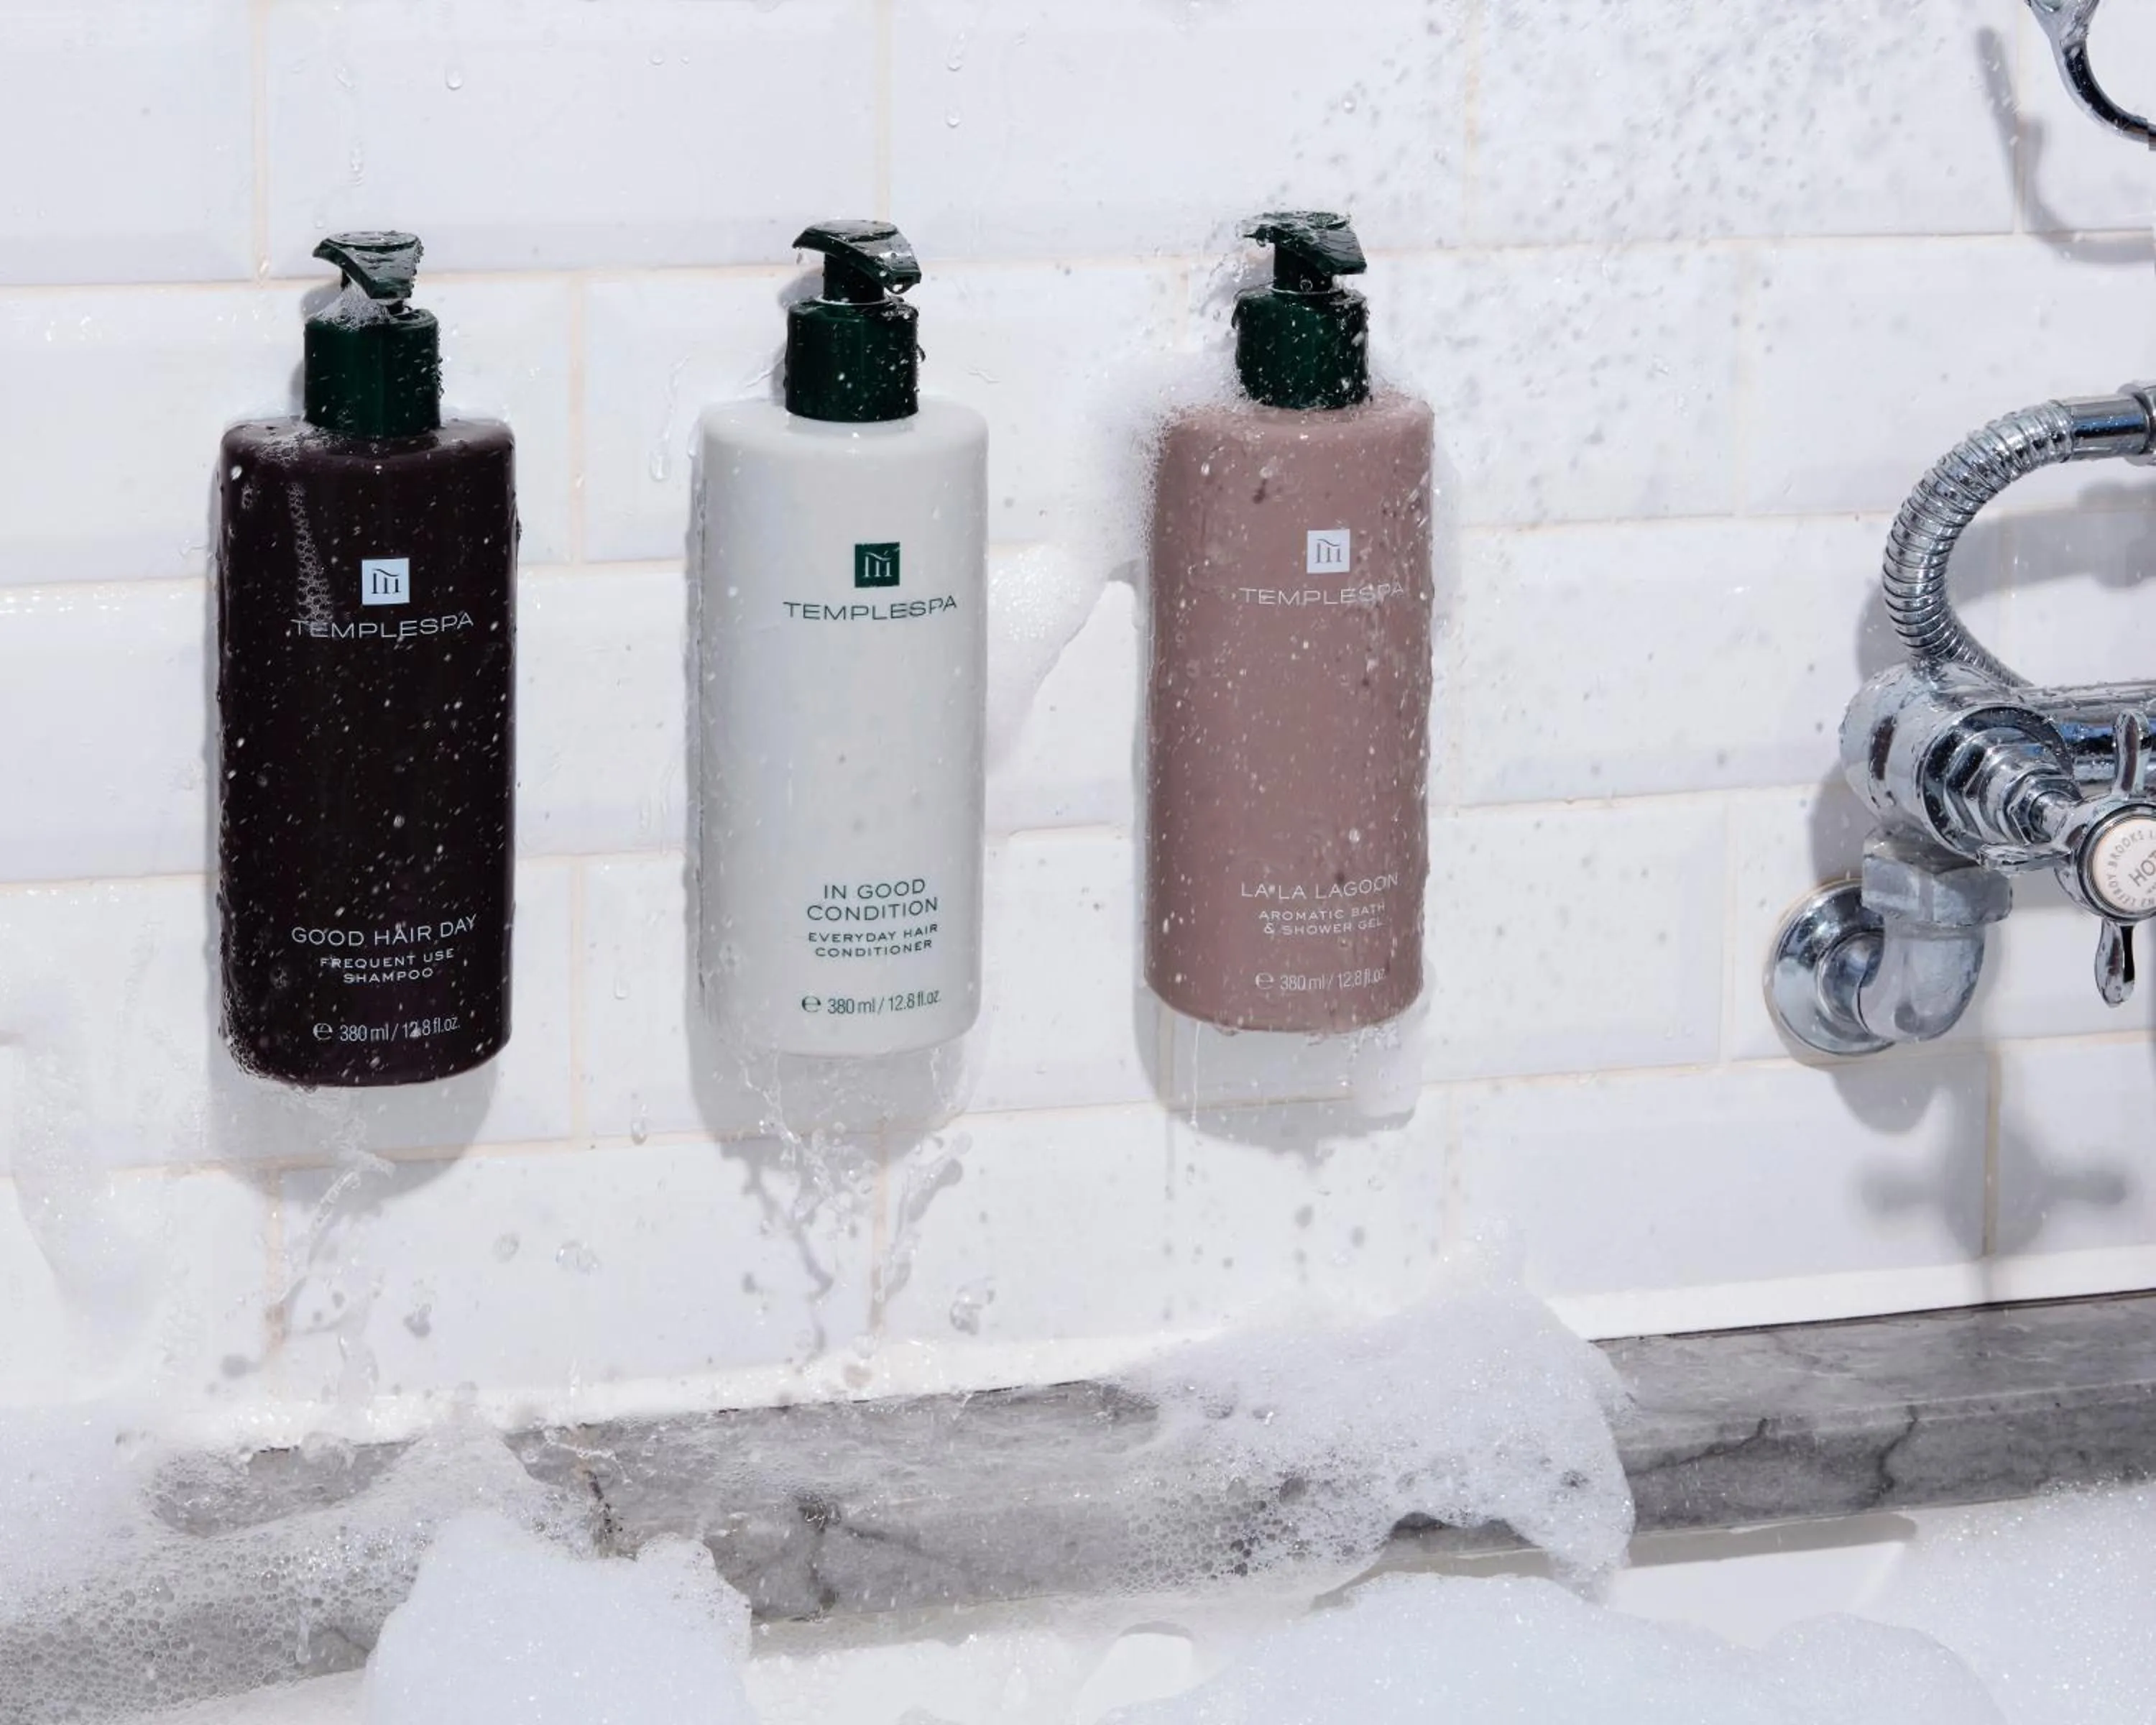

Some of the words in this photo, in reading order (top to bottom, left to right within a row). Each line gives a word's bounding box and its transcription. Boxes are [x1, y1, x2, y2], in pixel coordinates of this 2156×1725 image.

[1239, 576, 1404, 605] TEMPLESPA
[783, 595, 957, 620] TEMPLESPA
[290, 612, 474, 638] TEMPLESPA
[2107, 830, 2145, 868] BROOKS
[824, 885, 847, 899] IN
[857, 878, 926, 899] GOOD
[1241, 883, 1269, 898] LA
[1279, 885, 1307, 901] LA
[1315, 872, 1399, 899] LAGOON
[807, 897, 938, 921] CONDITION
[1258, 909, 1345, 921] AROMATIC
[1351, 901, 1386, 917] BATH
[291, 927, 364, 947] GOOD
[374, 925, 432, 946] HAIR
[440, 914, 476, 938] DAY
[808, 932, 897, 942] EVERYDAY
[903, 924, 938, 939] HAIR
[1263, 922, 1276, 934] &
[1281, 922, 1353, 935] SHOWER
[1358, 916, 1384, 929] GEL
[320, 954, 416, 969] FREQUENT
[423, 948, 455, 963] USE
[815, 939, 933, 957] CONDITIONER
[344, 968, 433, 983] SHAMPOO
[1280, 975, 1306, 990] 380
[828, 998, 854, 1014] 380
[889, 993, 915, 1011] 12.8
[339, 1024, 367, 1041] 380
